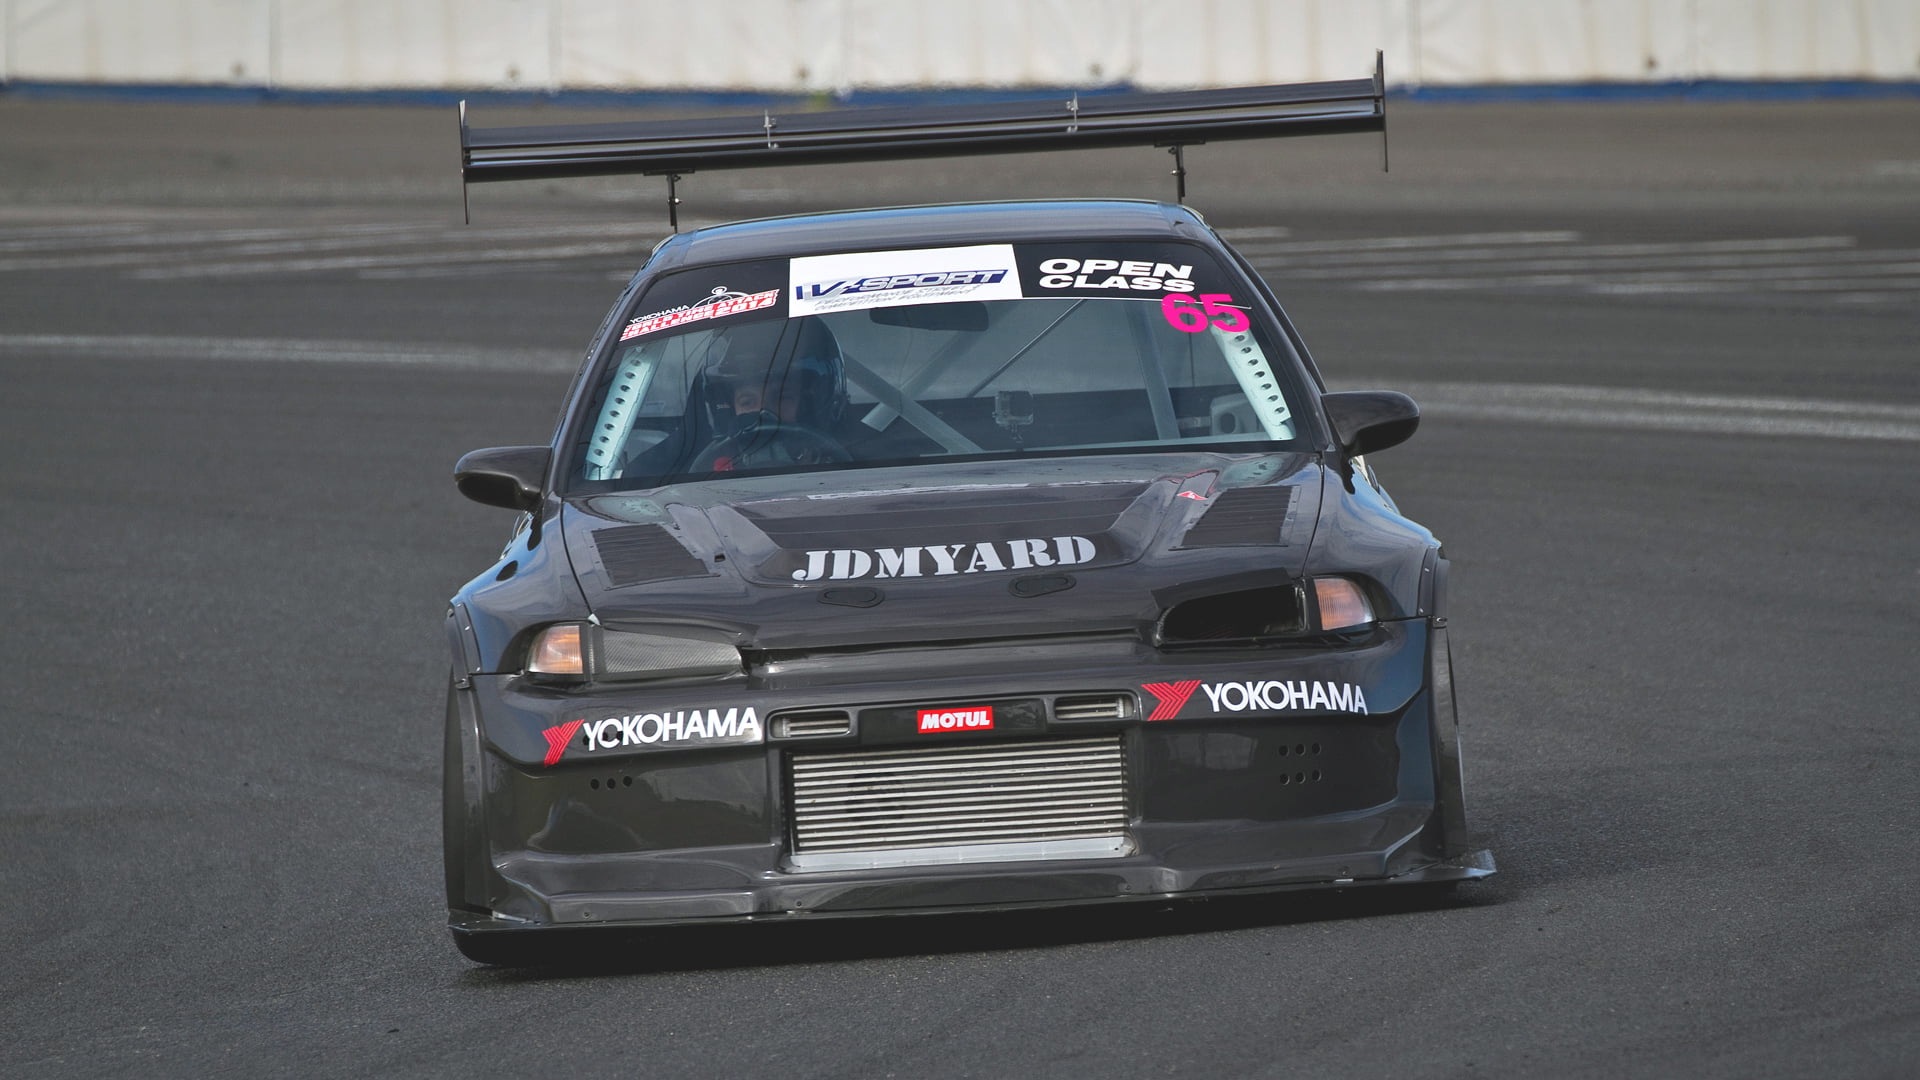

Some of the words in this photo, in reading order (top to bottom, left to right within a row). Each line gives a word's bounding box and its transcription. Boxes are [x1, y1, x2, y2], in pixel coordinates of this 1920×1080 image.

[1039, 259, 1193, 279] OPEN
[1039, 275, 1195, 292] CLASS
[630, 304, 690, 324] YOKOHAMA
[717, 297, 774, 315] 2014
[1161, 293, 1250, 333] 65
[791, 536, 1096, 581] JDMYARD
[1201, 680, 1368, 715] YOKOHAMA
[583, 707, 762, 751] YOKOHAMA
[921, 711, 990, 729] MOTUL
